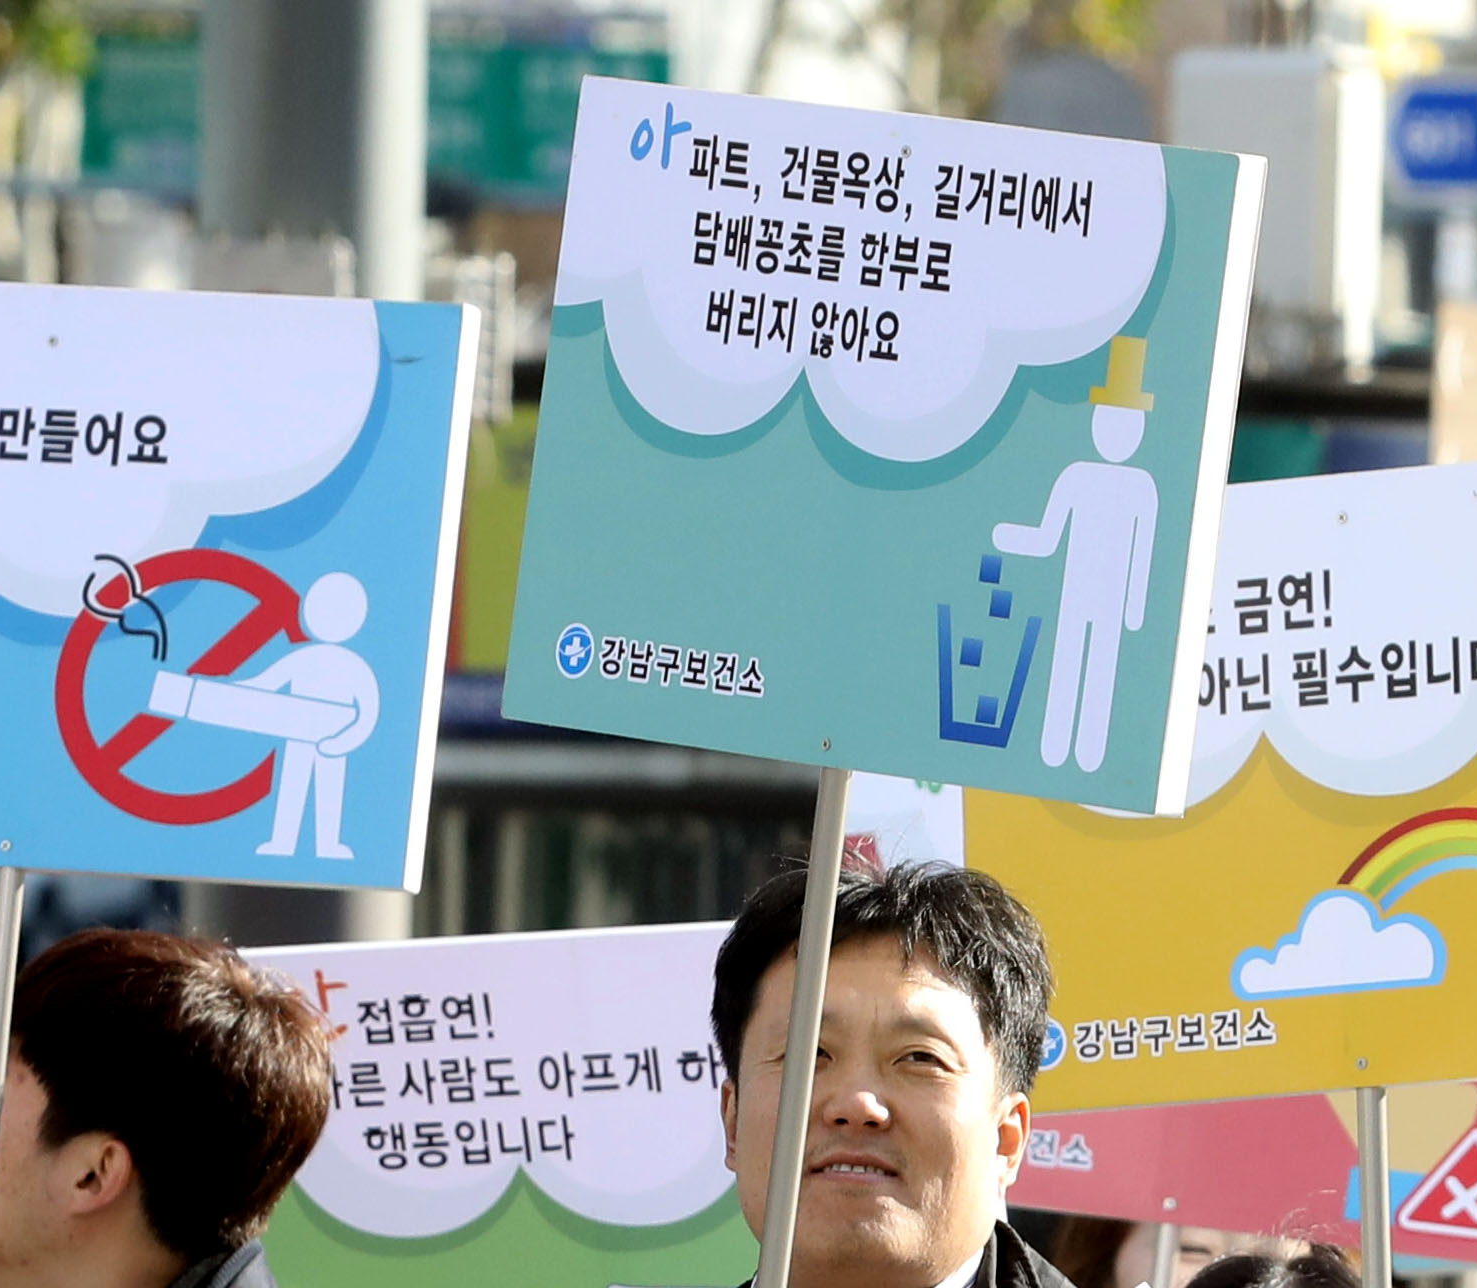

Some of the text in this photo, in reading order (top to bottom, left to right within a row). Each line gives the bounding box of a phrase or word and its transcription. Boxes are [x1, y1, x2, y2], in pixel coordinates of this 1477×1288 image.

[779, 145, 913, 221] 건물옥상,
[933, 163, 1095, 238] 길거리에서
[693, 210, 953, 293] 담배꽁초를 함부로
[704, 291, 901, 363] 버리지 않아요
[1233, 569, 1333, 636] 금연!
[599, 636, 766, 698] 강남구보건소
[1198, 654, 1272, 716] 아닌
[1073, 1010, 1278, 1058] 강남구보건소
[399, 1056, 521, 1105] 사람도
[538, 1046, 662, 1100] 아프게
[363, 1114, 577, 1171] 행동입니다
